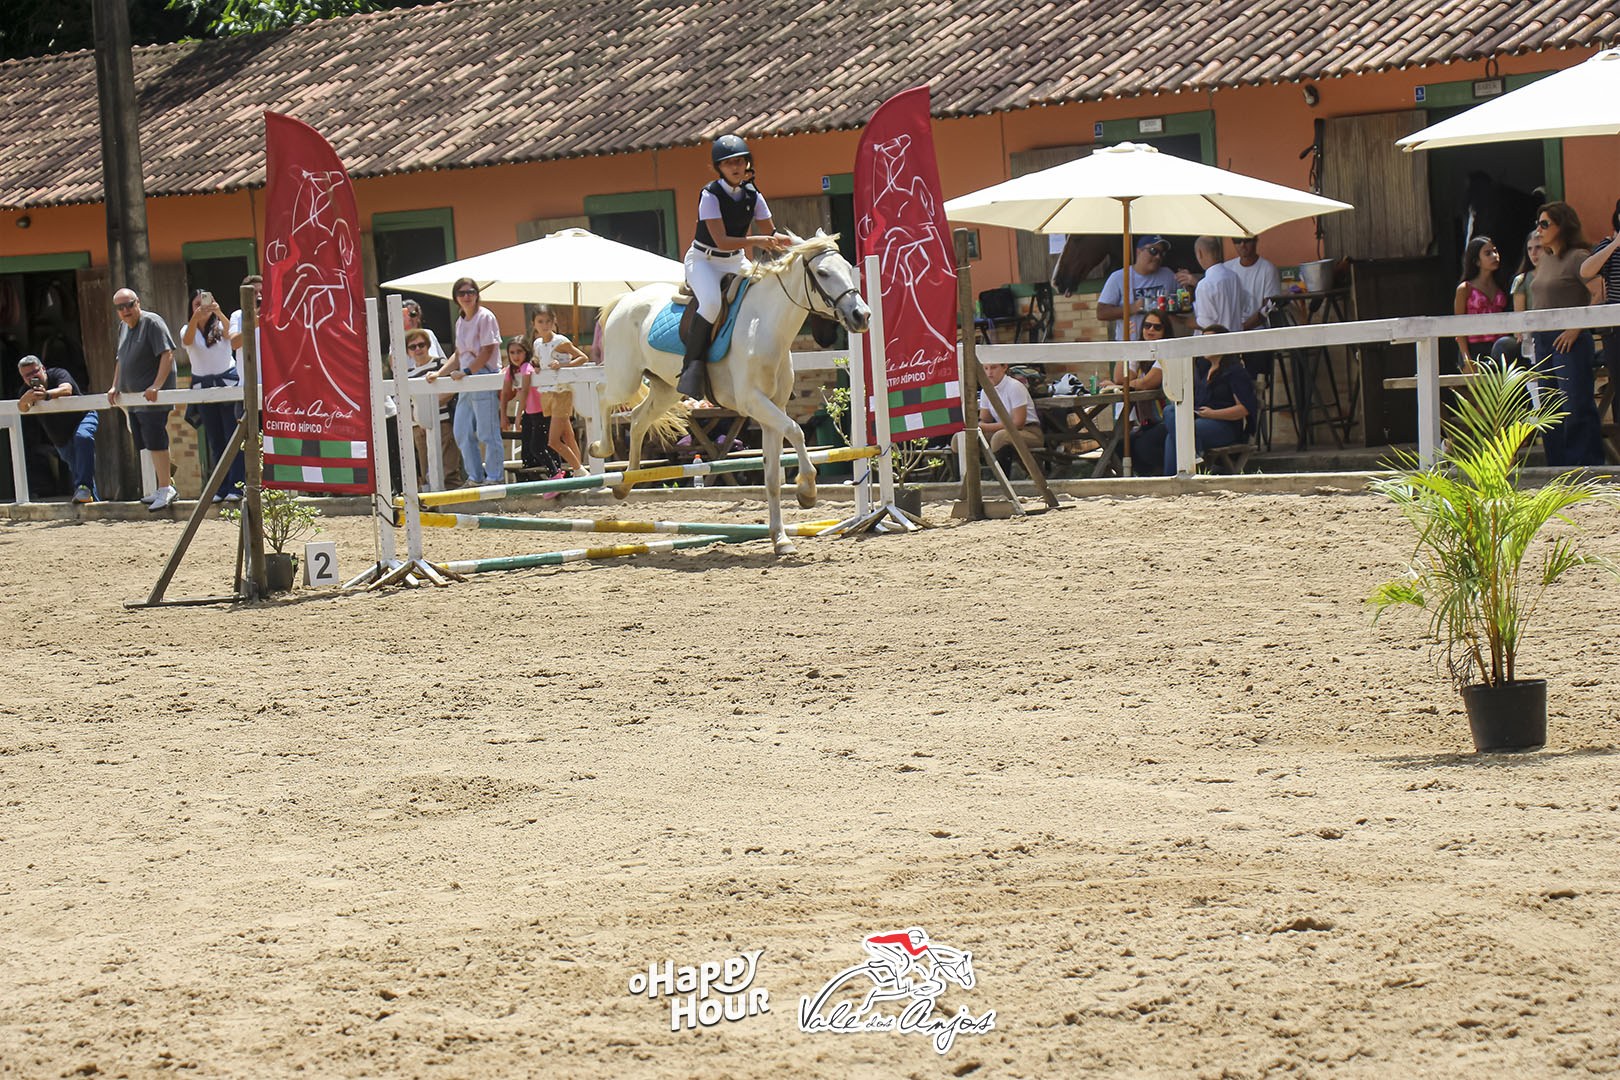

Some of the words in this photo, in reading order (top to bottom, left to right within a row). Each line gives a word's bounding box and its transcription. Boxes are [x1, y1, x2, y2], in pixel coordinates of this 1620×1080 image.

[909, 349, 950, 375] Anjos
[901, 371, 926, 385] HÍPICO
[264, 380, 295, 415] Vale
[306, 399, 354, 429] Anjos
[265, 420, 297, 432] CENTRO
[298, 421, 323, 434] HÍPICO
[314, 551, 333, 580] 2
